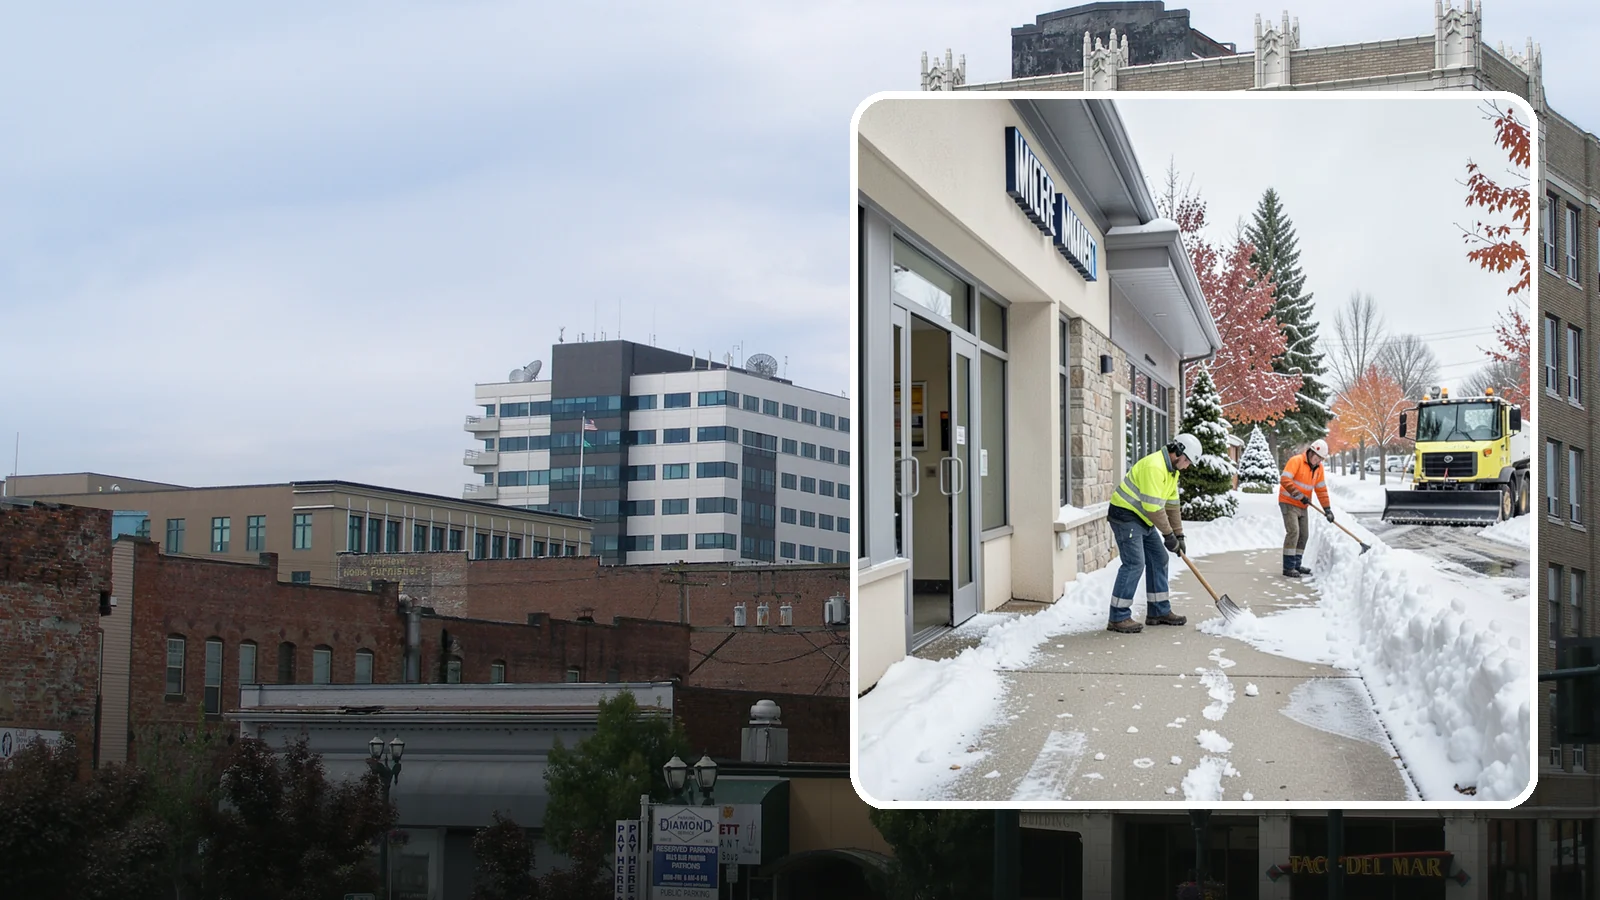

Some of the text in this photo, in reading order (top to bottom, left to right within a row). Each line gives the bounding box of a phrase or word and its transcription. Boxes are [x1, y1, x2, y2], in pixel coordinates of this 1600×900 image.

[343, 566, 427, 577] Home Furnishers
[660, 818, 713, 832] DIAMOND
[1021, 814, 1070, 828] BUILDING
[656, 845, 716, 854] RESERVED PARKING
[616, 825, 625, 893] PAY HERE
[627, 824, 637, 893] PAY HERE
[671, 862, 701, 870] PATRONS
[1346, 856, 1385, 876] DEL
[1392, 857, 1442, 877] MAR
[660, 888, 710, 899] PUBLIC PARKING
